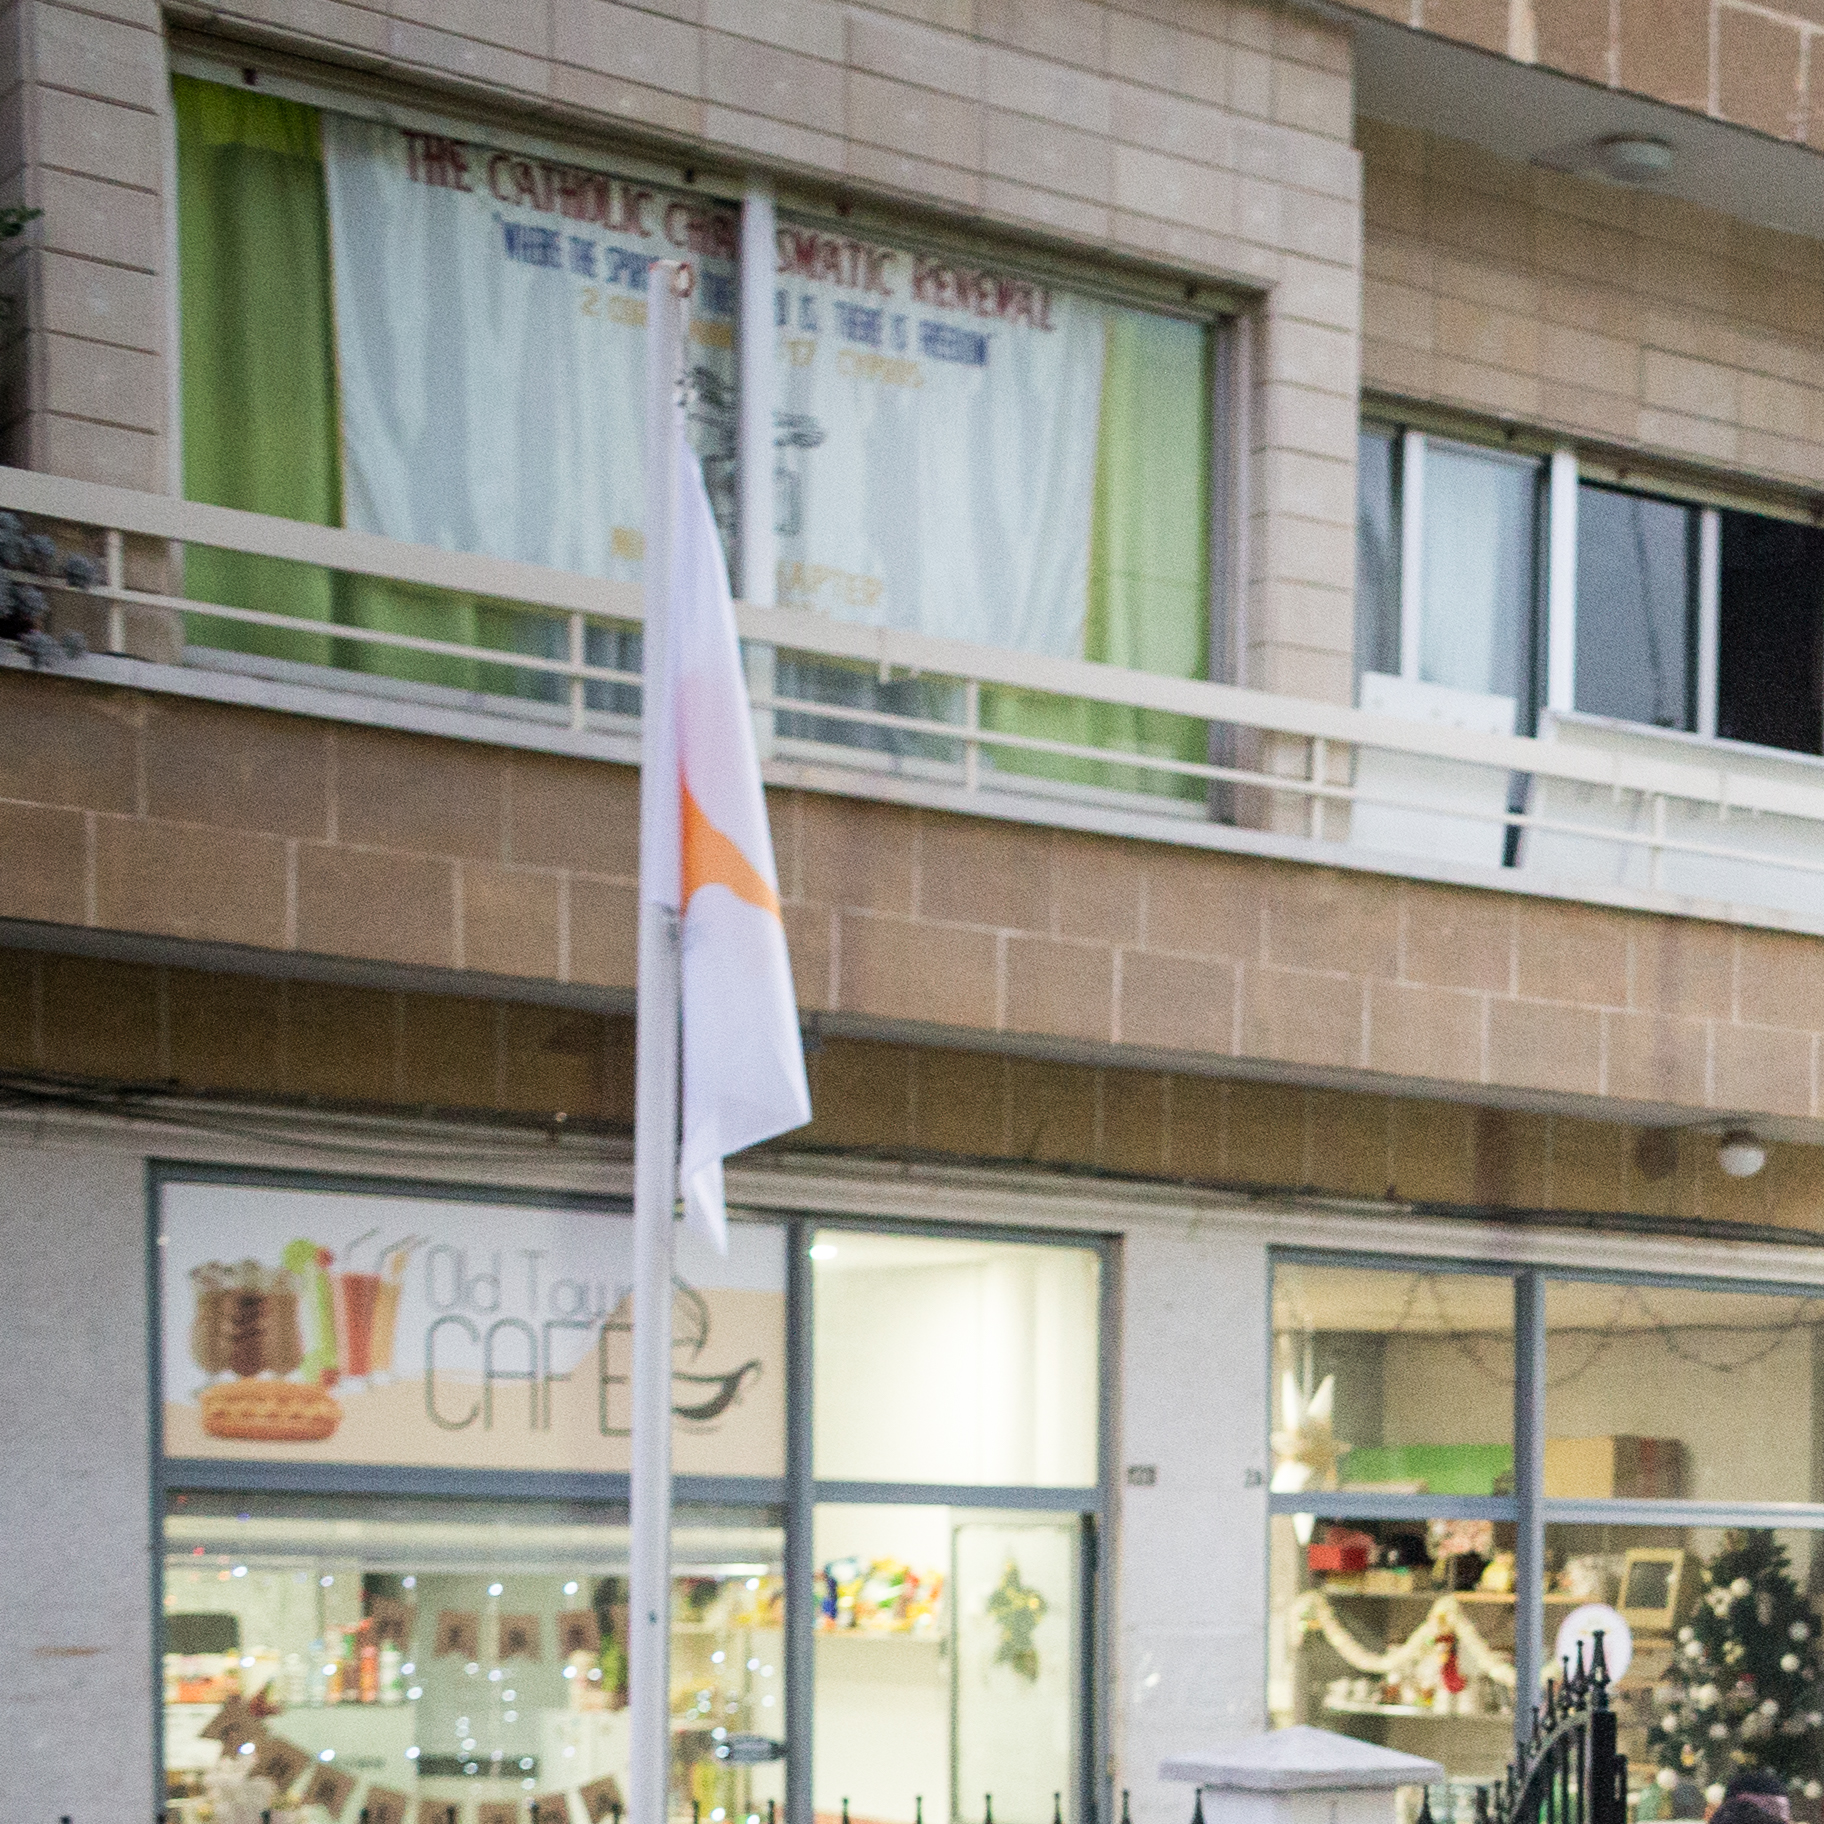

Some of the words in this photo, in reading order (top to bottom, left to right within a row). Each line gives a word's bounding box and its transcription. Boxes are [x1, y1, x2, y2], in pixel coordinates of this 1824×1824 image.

[402, 128, 473, 194] THE
[487, 150, 653, 239] CATHOLIC
[911, 248, 1054, 334] RENEWAL
[425, 1243, 500, 1315] Old
[425, 1313, 633, 1438] CAFE
